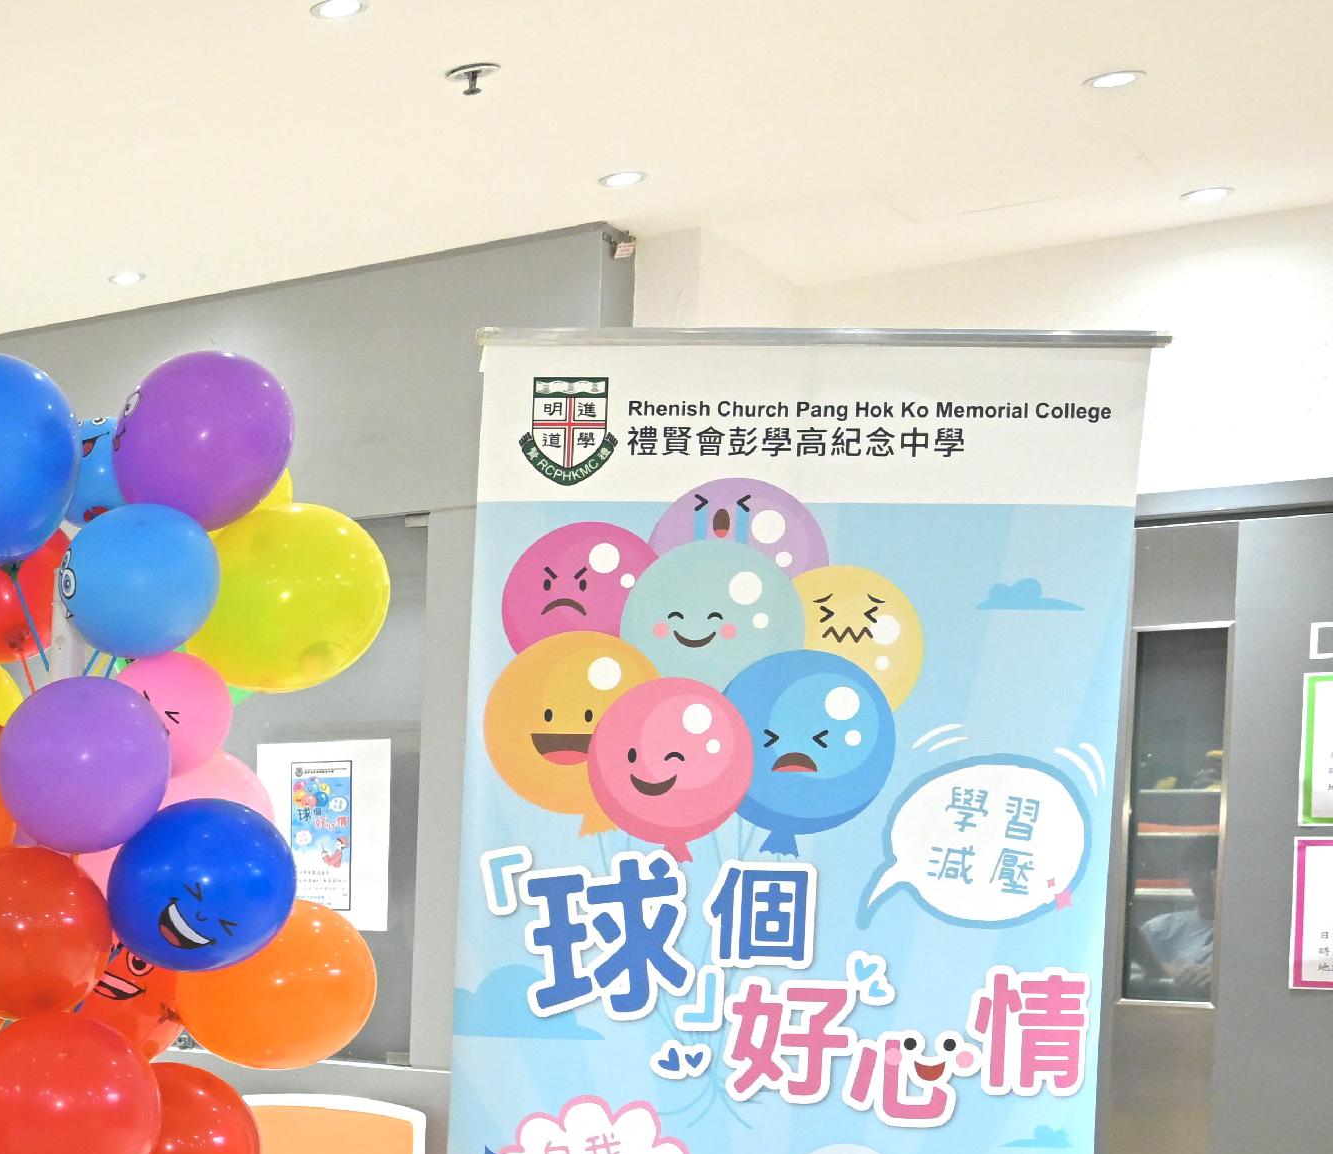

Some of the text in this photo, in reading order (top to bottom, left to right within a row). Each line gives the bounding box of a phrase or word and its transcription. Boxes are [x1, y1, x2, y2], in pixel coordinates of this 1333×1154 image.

[628, 400, 1113, 424] Rhenish Church Pang Hok Ko Memorial College
[627, 426, 966, 459] 禮賢會彭學高紀念中學
[536, 458, 600, 482] RCPHKMC
[945, 786, 1040, 841] 學習
[927, 845, 1035, 895] 減壓
[731, 973, 1086, 1120] 好心情
